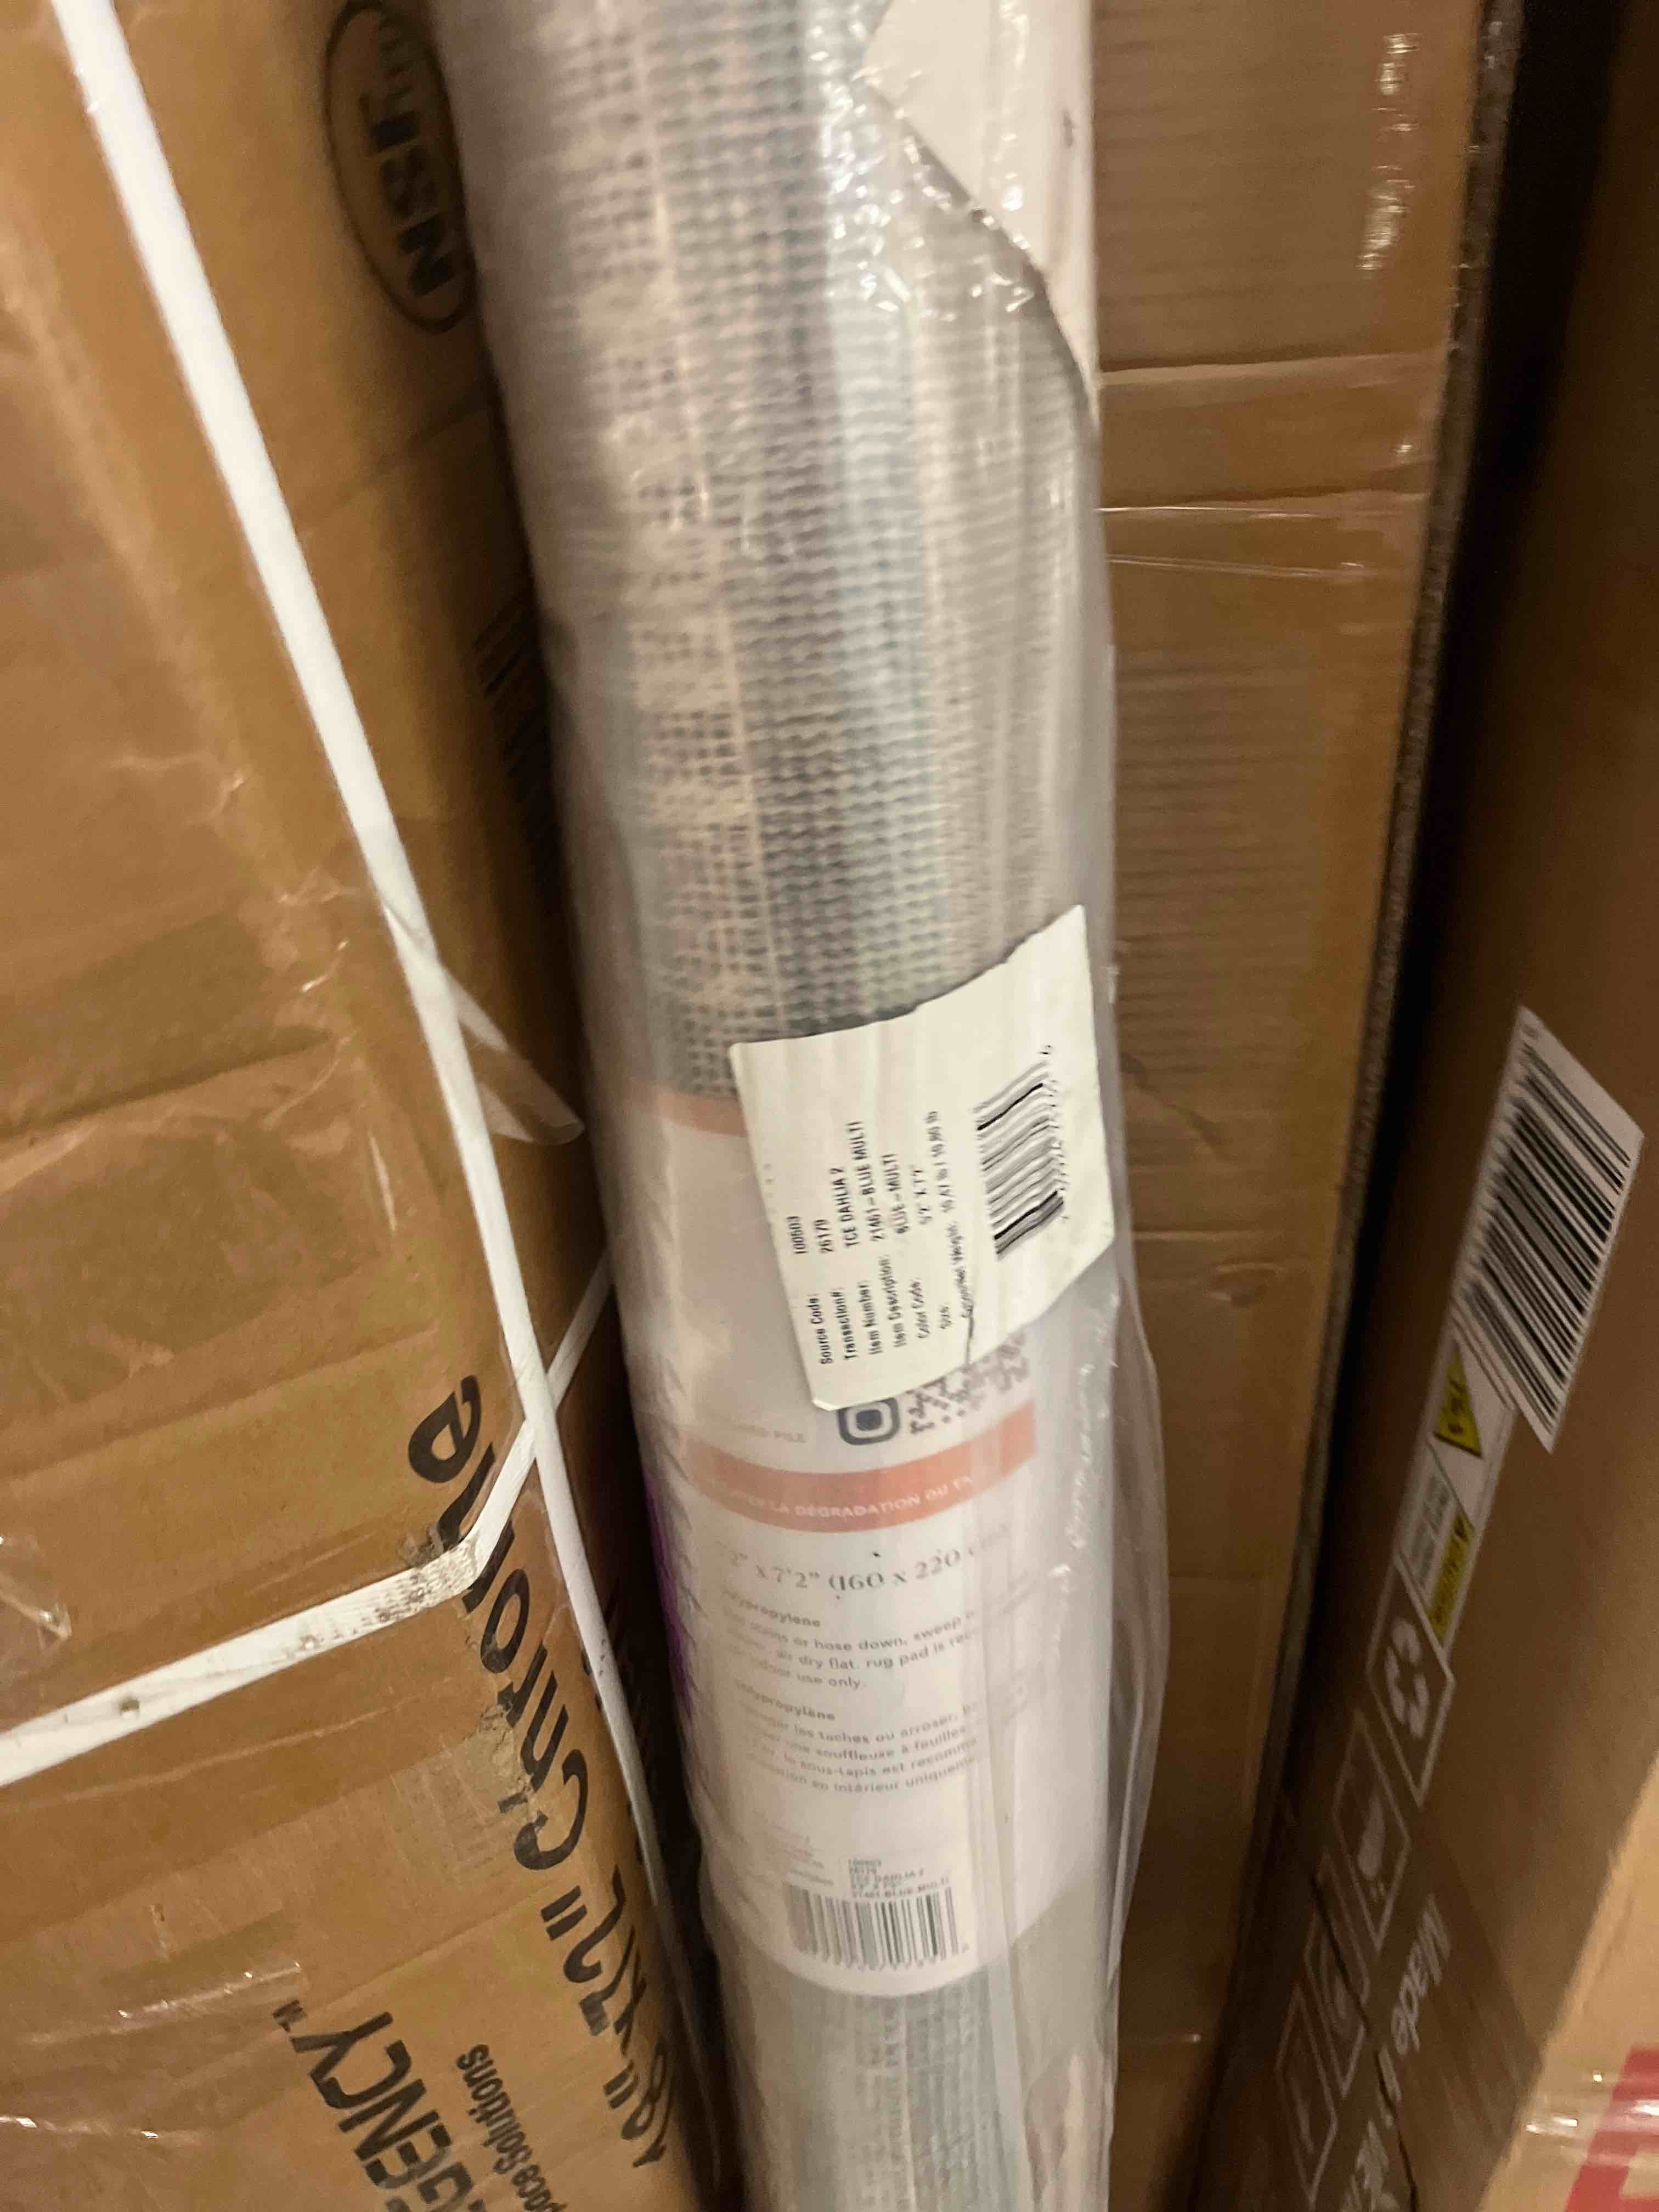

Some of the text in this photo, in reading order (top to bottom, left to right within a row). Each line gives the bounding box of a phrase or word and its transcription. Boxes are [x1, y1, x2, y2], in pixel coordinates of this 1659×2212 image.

[847, 1121, 868, 1160] MULTI
[831, 1177, 854, 1222] DAHLIA
[842, 1226, 860, 1248] TCE
[893, 1322, 907, 1348] Item
[916, 1312, 932, 1339] Color
[819, 1328, 834, 1365] Source
[868, 1330, 884, 1355] Item
[795, 1493, 922, 1519] DÉGRADATION
[827, 1570, 885, 1593] (160
[913, 1548, 963, 1579] 220
[814, 1638, 853, 1652] hose
[913, 1615, 962, 1641] sweep
[798, 1655, 824, 1671] dry
[866, 1656, 895, 1670] rug
[898, 1643, 930, 1668] pad
[796, 1672, 823, 1685] use
[456, 2044, 533, 2175] Solutions
